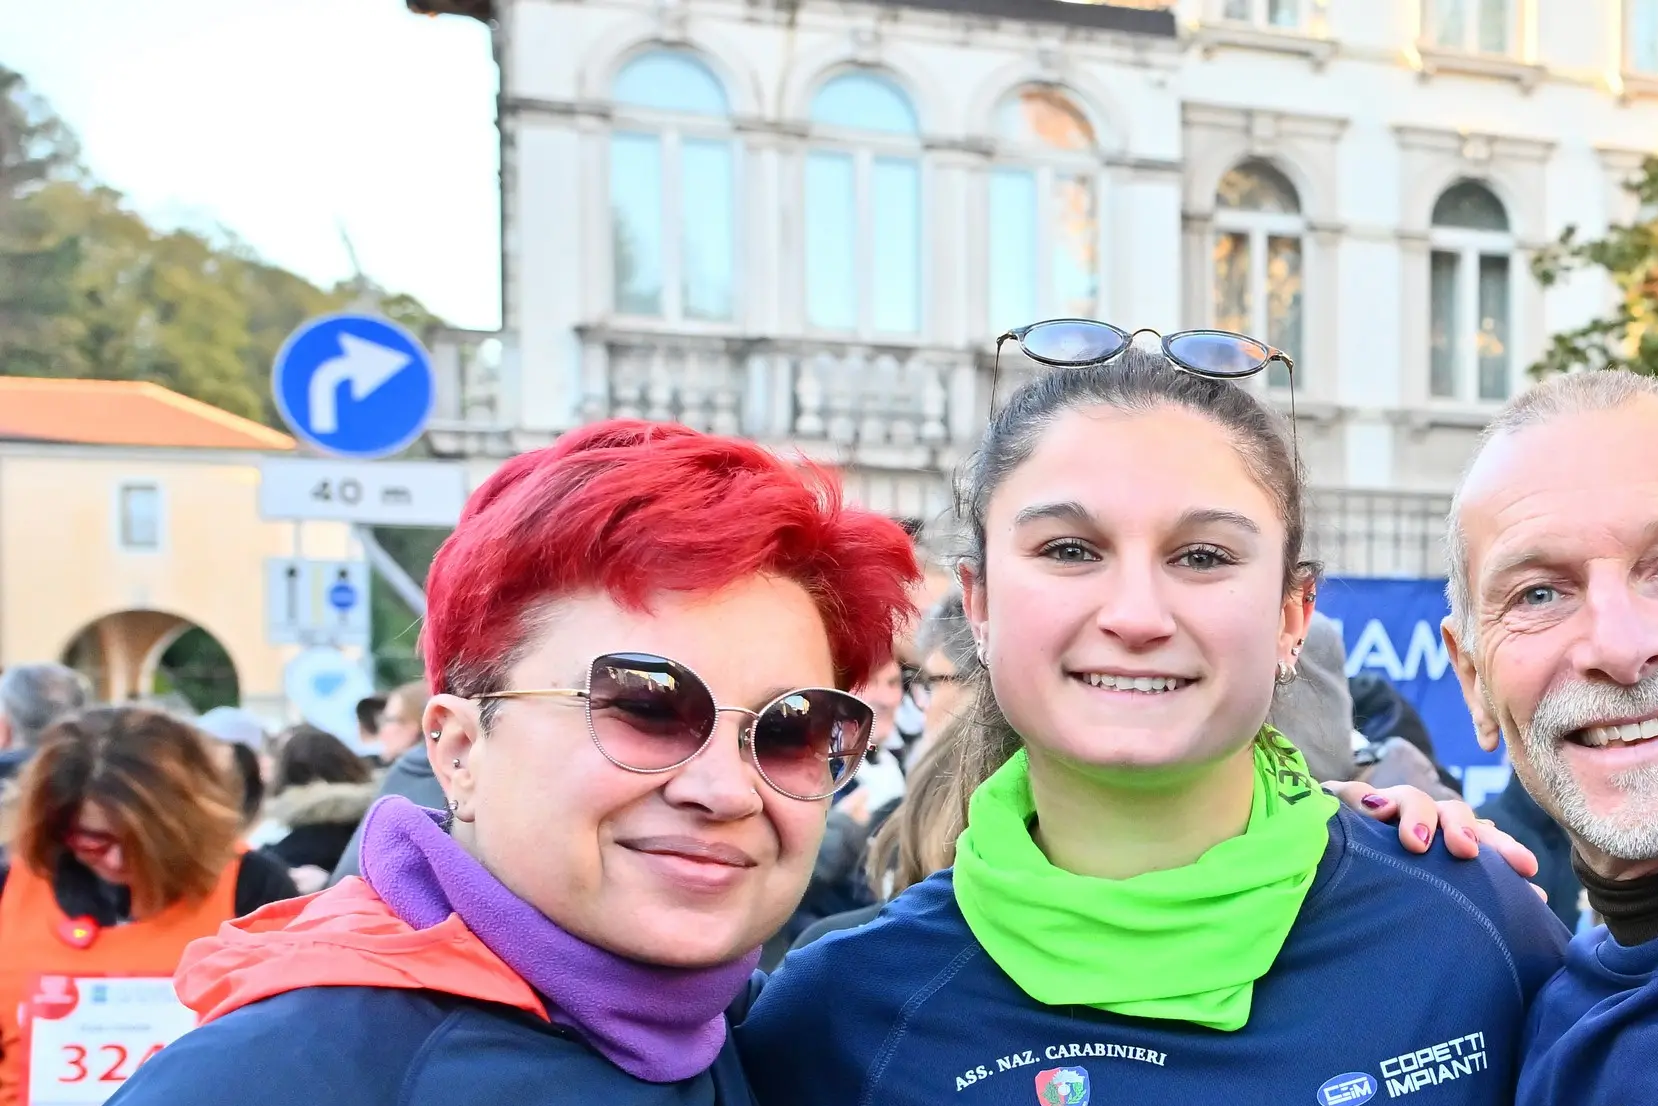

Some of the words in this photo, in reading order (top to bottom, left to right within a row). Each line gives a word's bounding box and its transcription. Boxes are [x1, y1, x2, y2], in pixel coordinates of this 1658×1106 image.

[311, 477, 363, 506] 40
[955, 1065, 993, 1092] ASS.
[996, 1050, 1040, 1073] NAZ.
[1045, 1043, 1167, 1067] CARABINIERI
[1379, 1031, 1485, 1078] COPETTI
[1386, 1050, 1488, 1099] IMPIANTI
